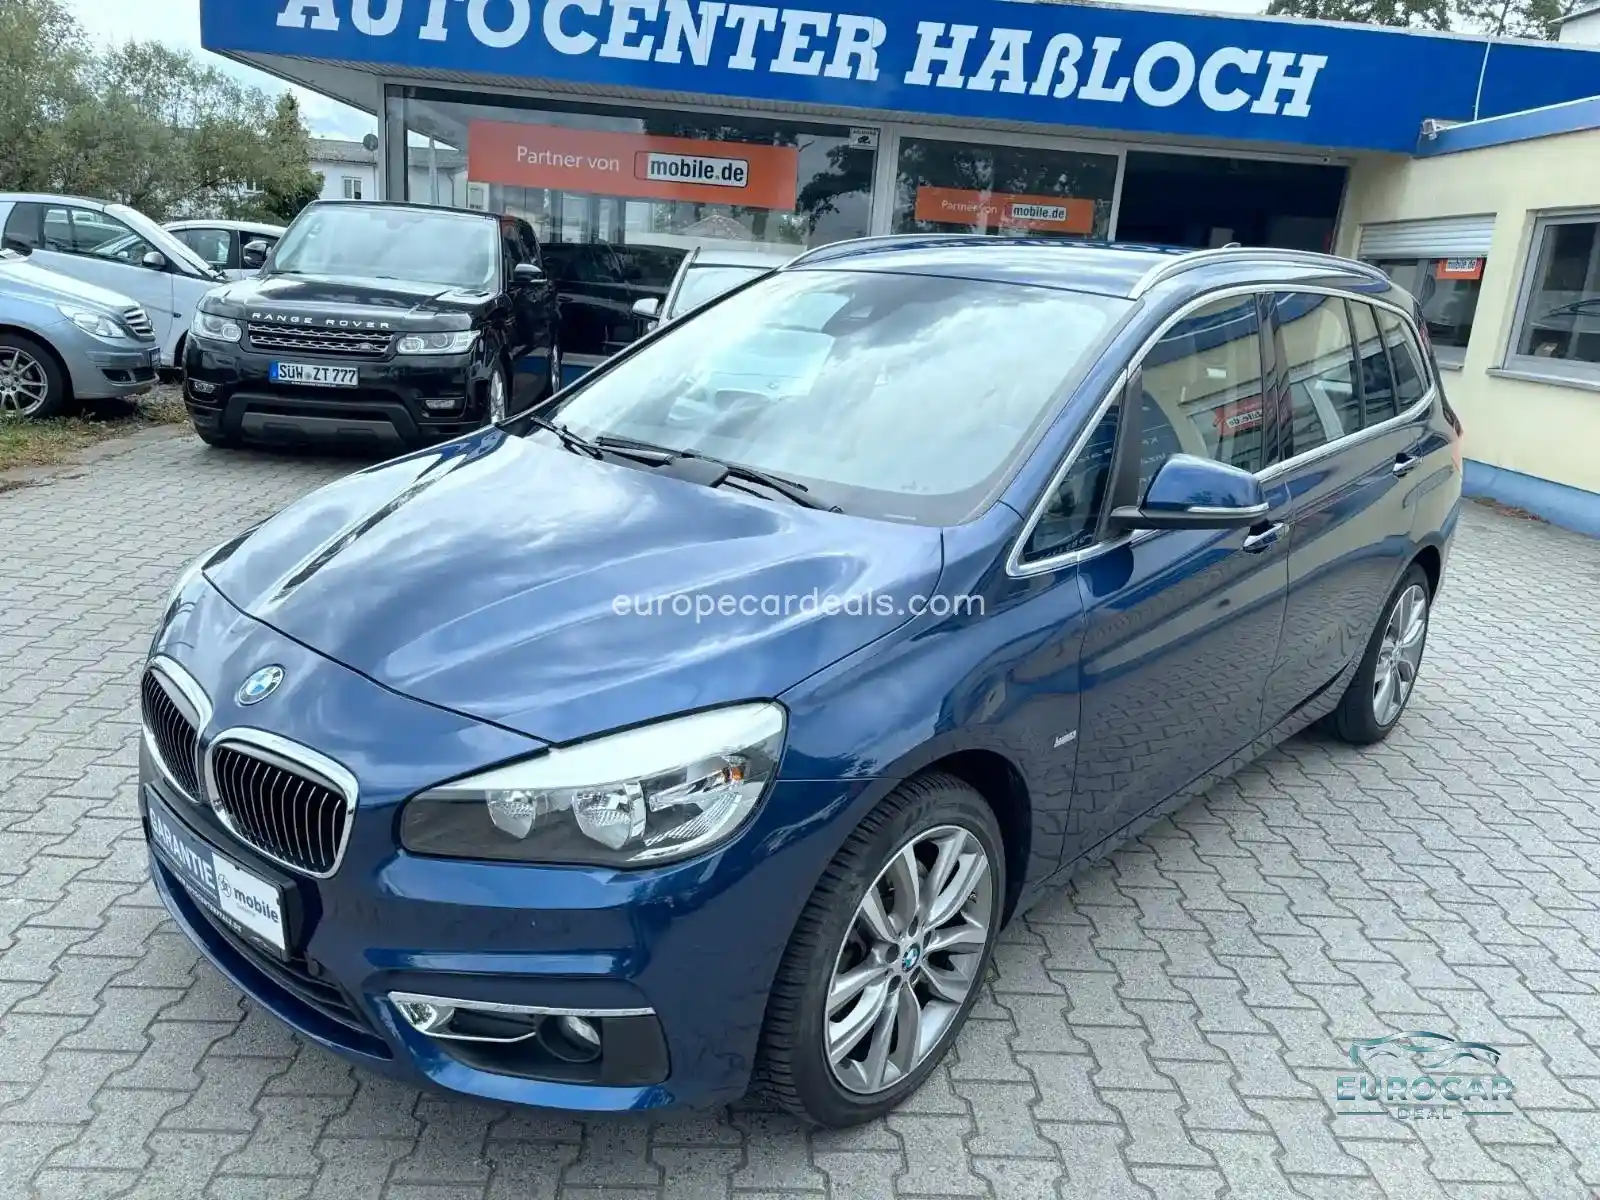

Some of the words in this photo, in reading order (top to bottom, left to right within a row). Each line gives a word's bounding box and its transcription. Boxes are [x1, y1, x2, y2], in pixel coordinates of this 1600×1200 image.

[275, 0, 888, 81] AUTOCENTER
[904, 21, 1328, 117] HAßLOCH
[516, 145, 583, 169] Partner
[587, 157, 620, 173] von
[650, 157, 745, 183] mobile.de
[941, 200, 977, 213] Partner
[1012, 205, 1066, 220] mobile.de
[252, 312, 313, 324] RANGE
[325, 319, 390, 329] ROVER
[313, 367, 330, 381] ZT
[332, 368, 356, 383] 777
[149, 807, 217, 890] GARANTIE
[233, 887, 280, 924] mobile
